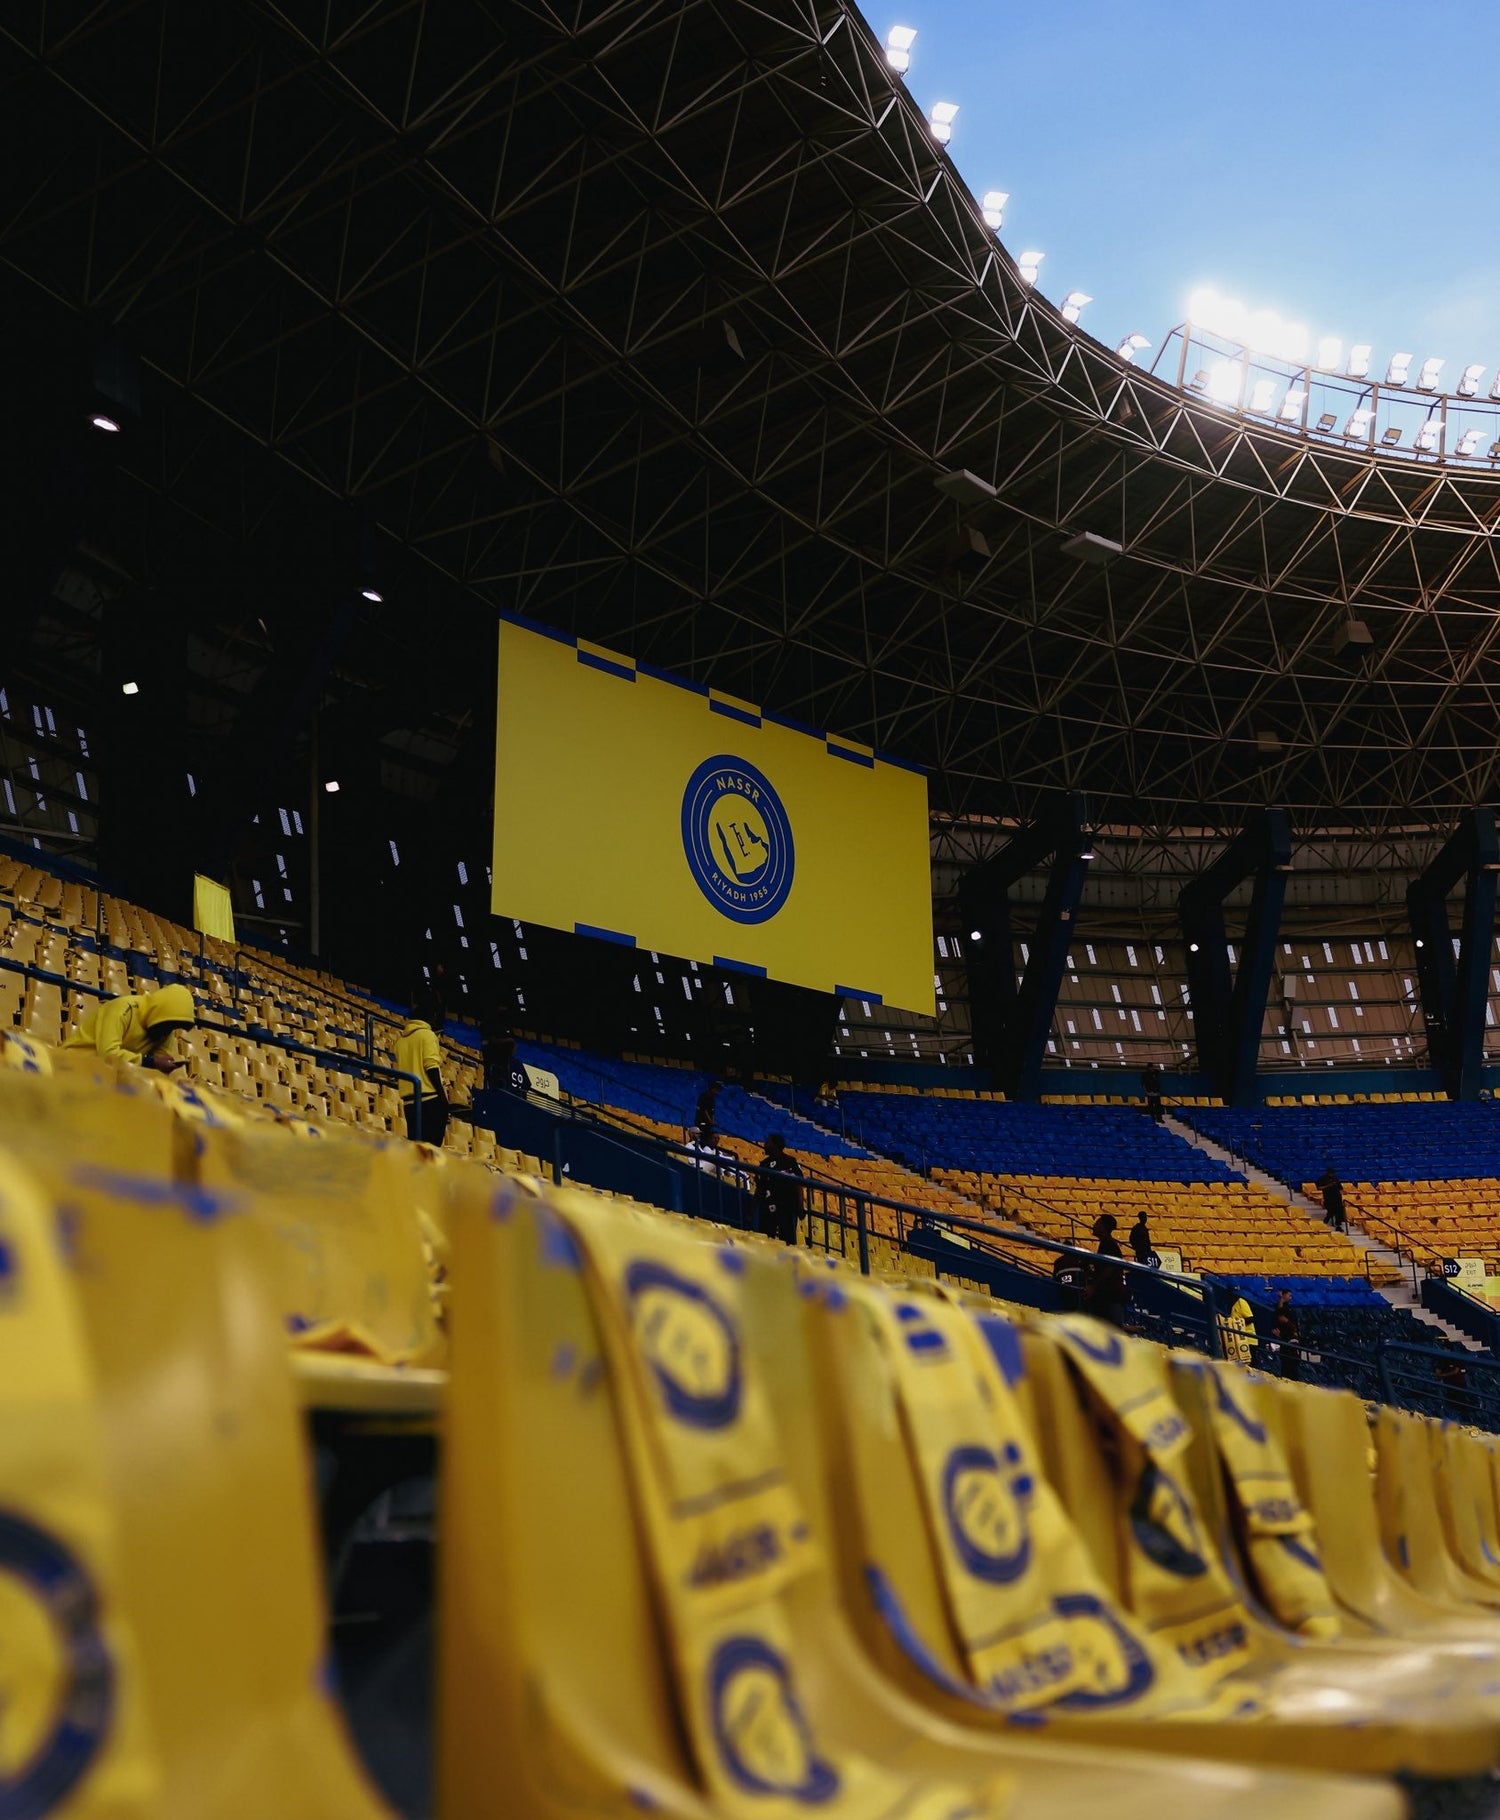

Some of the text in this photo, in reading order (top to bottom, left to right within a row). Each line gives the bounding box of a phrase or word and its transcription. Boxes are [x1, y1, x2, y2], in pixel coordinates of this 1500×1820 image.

[716, 776, 760, 803] NASSR
[711, 872, 768, 902] RIYADH 1955
[1147, 1257, 1158, 1267] S11
[1444, 1264, 1458, 1274] S12
